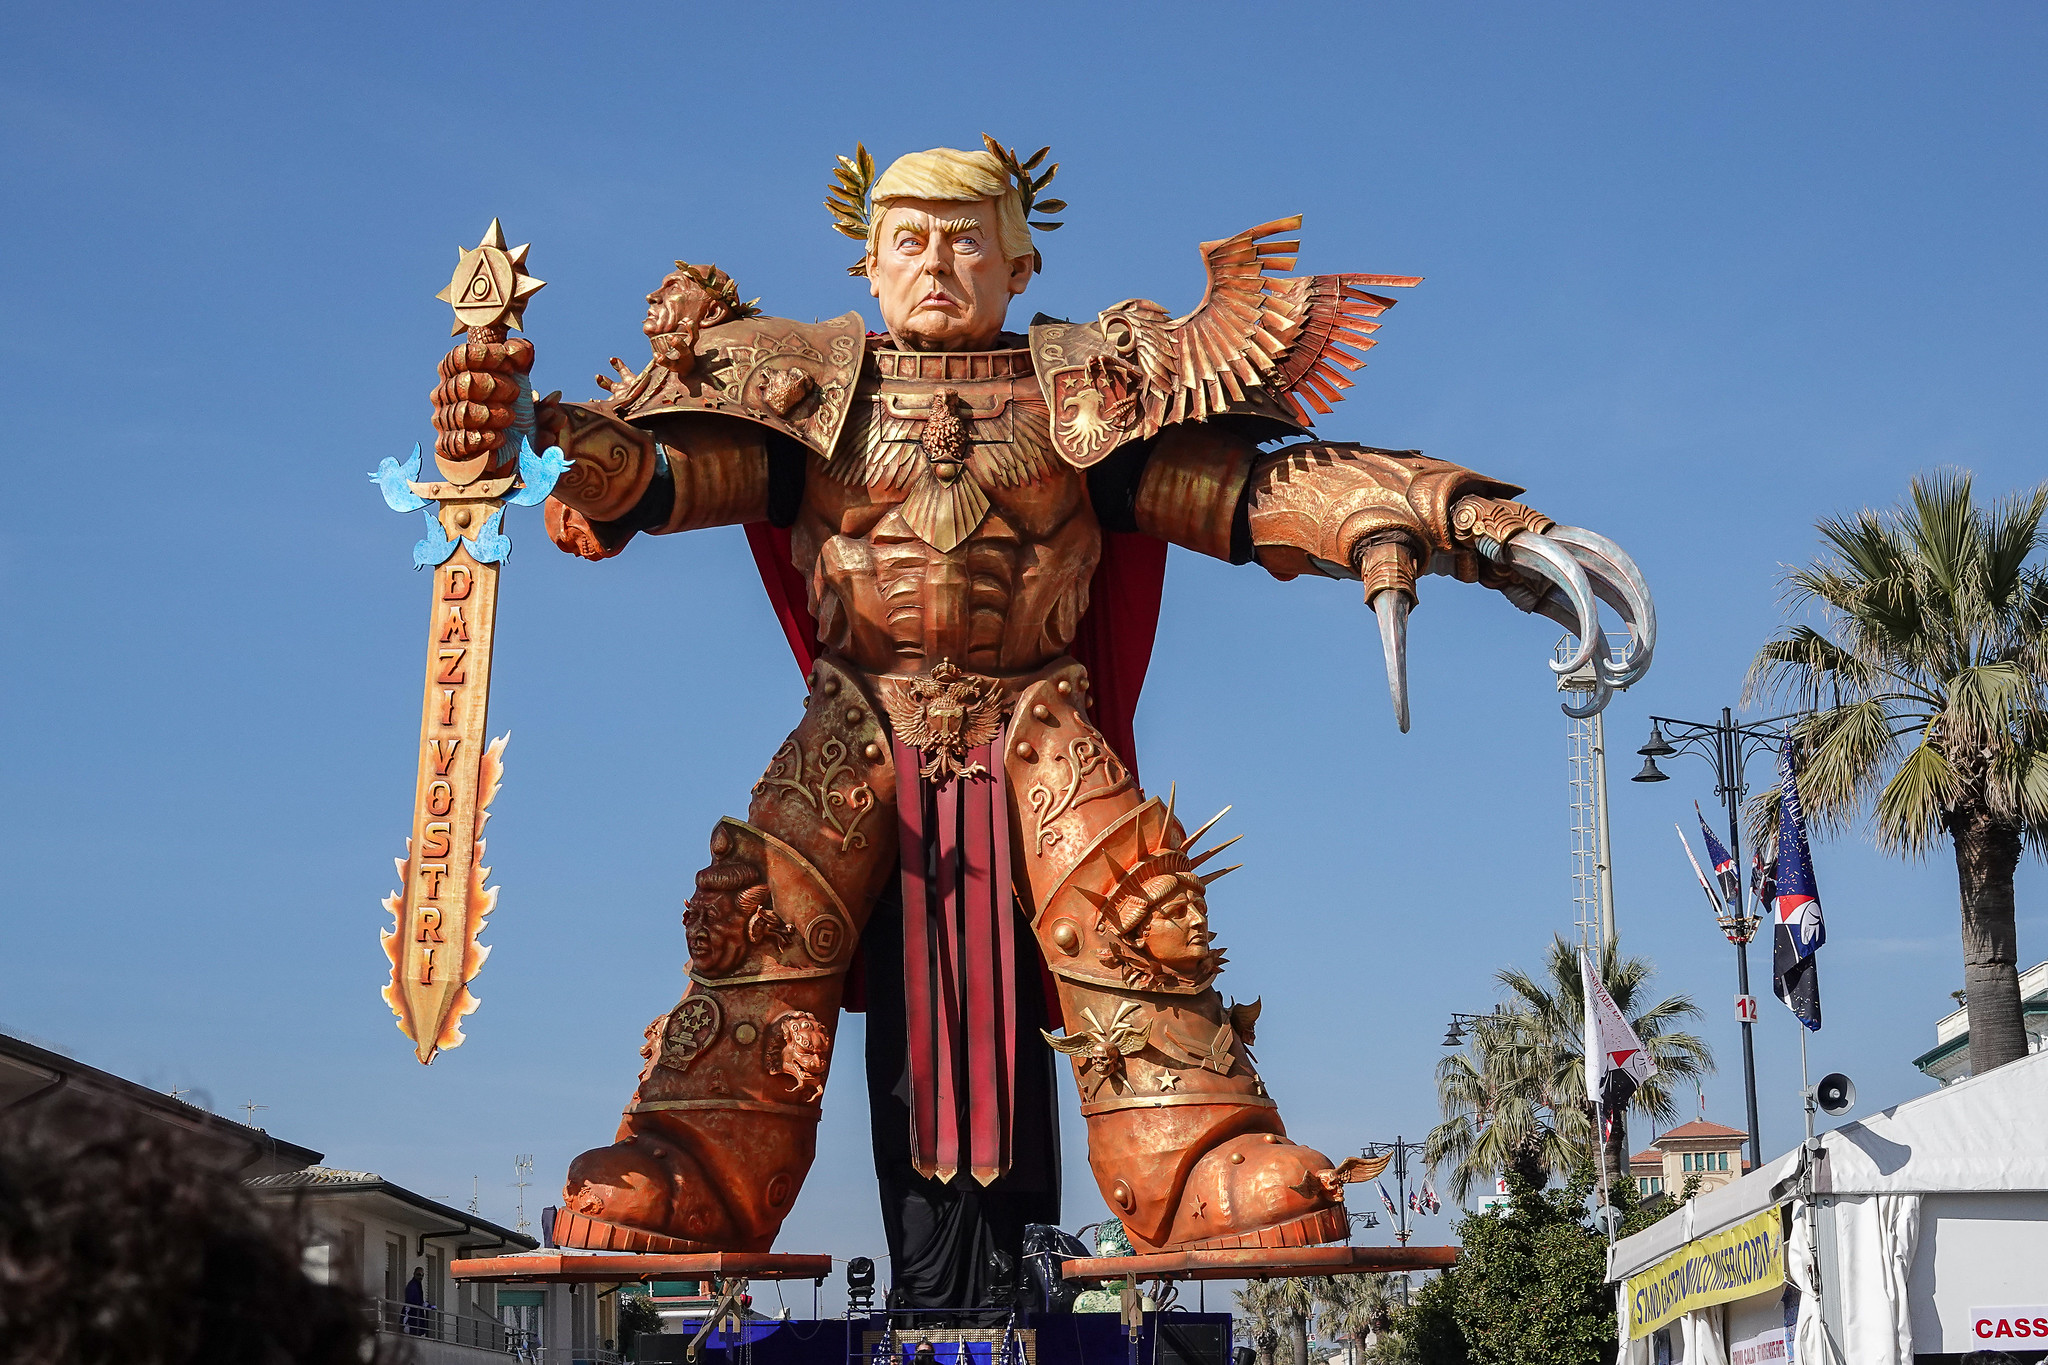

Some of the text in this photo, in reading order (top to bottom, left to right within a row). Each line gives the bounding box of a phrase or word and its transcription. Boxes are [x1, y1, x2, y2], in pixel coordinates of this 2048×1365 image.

[416, 564, 474, 986] DAZI VOSTRI
[1737, 998, 1757, 1020] 12
[1636, 1282, 1662, 1325] STAND
[1975, 1317, 2048, 1339] CASS
